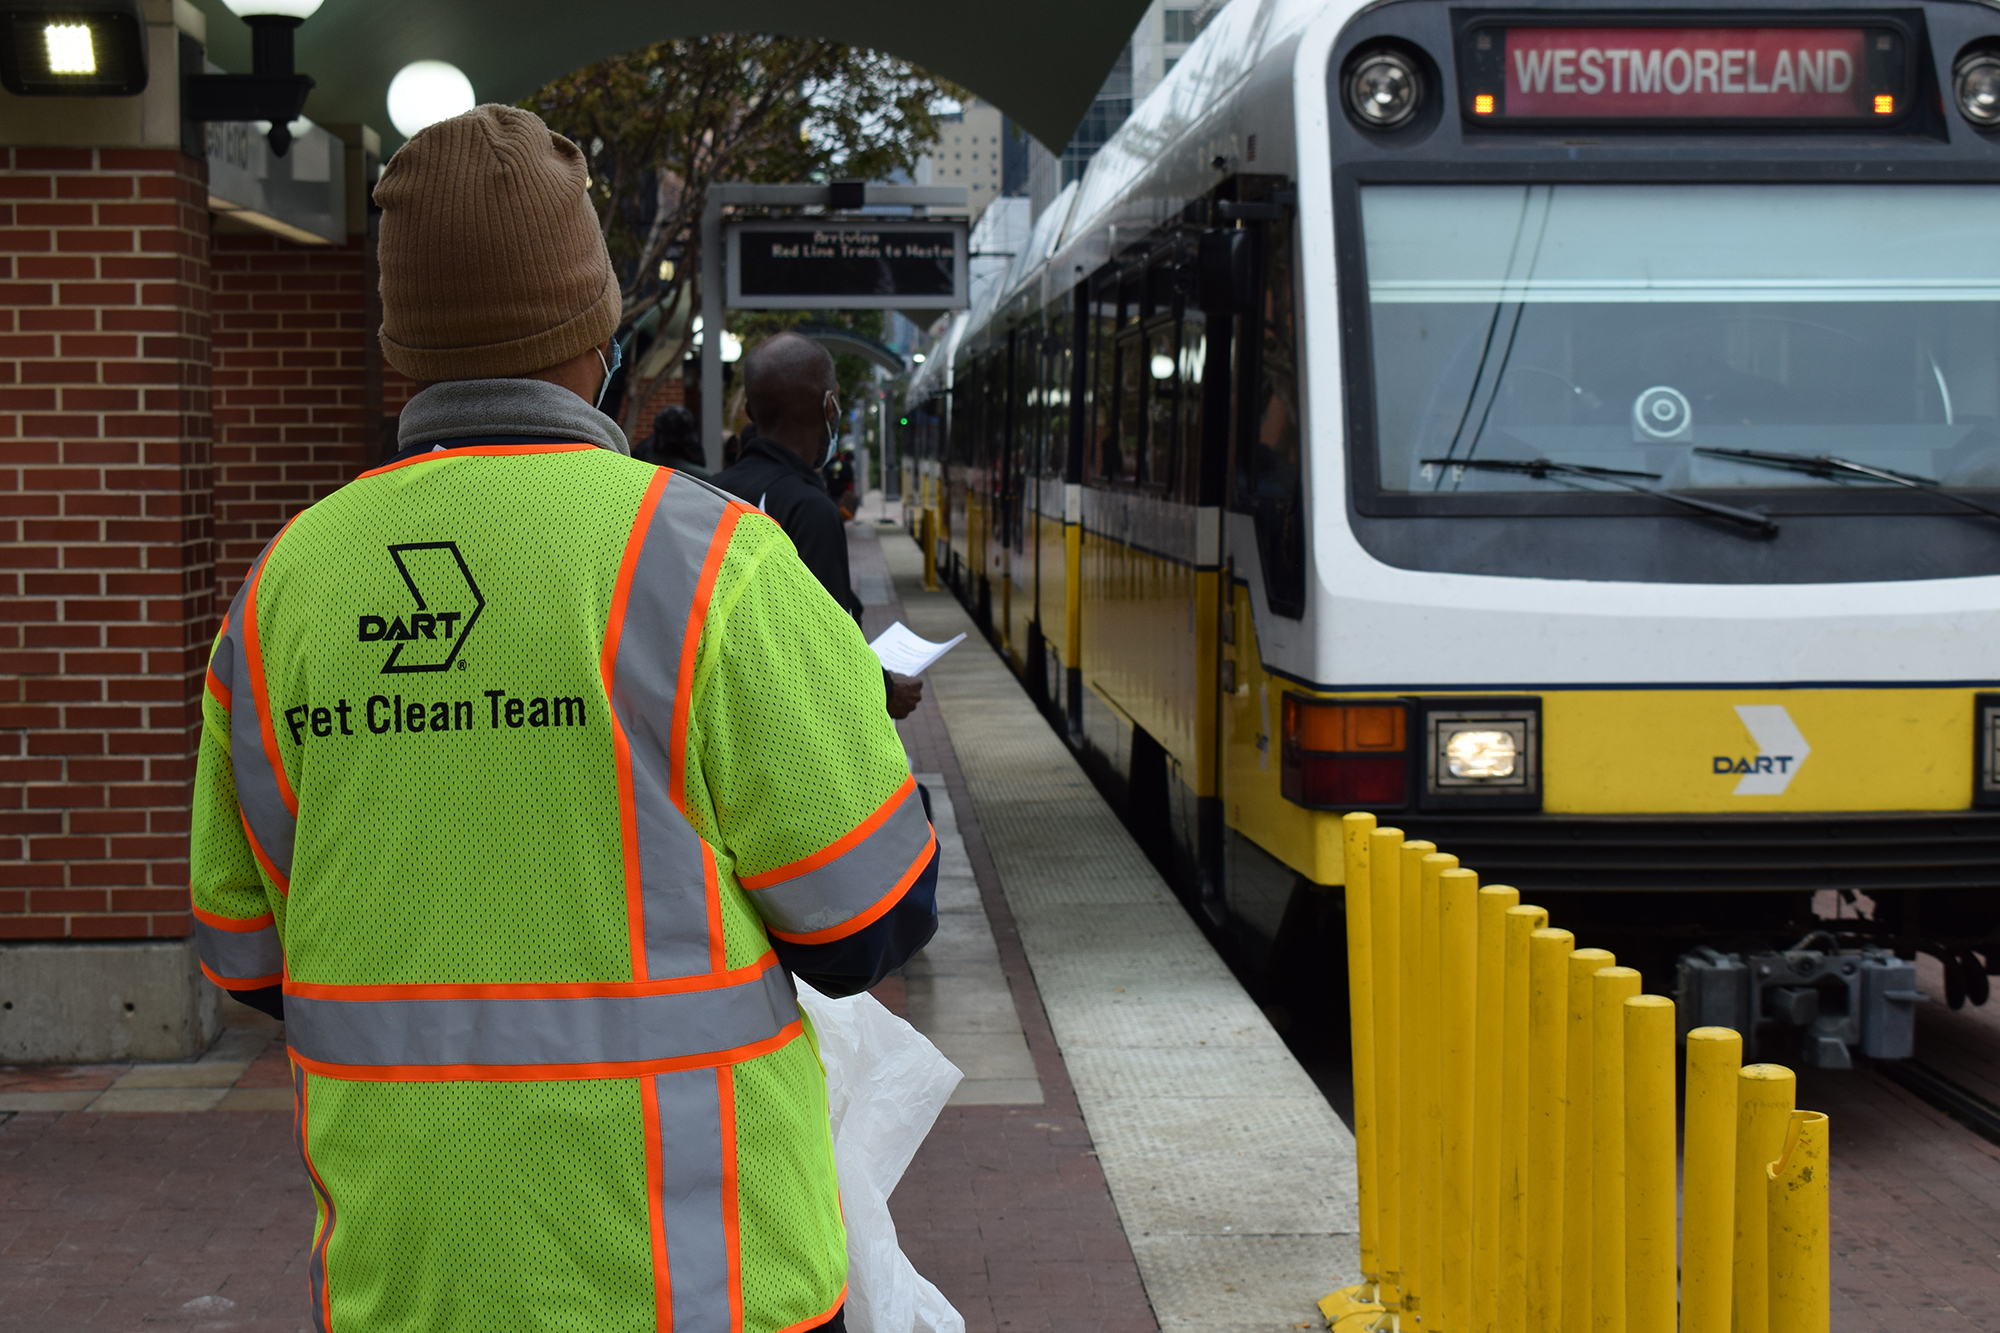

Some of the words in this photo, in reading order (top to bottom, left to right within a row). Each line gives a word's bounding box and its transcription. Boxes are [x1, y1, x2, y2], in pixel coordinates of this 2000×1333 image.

[1513, 48, 1853, 94] WESTMORELAND
[813, 230, 880, 245] Arriving
[771, 244, 799, 258] Red
[802, 244, 836, 258] Line
[840, 244, 881, 258] Train
[885, 244, 902, 258] to
[359, 612, 461, 641] DART
[366, 694, 473, 734] Clean
[484, 690, 586, 729] Team
[1713, 756, 1793, 773] DART
